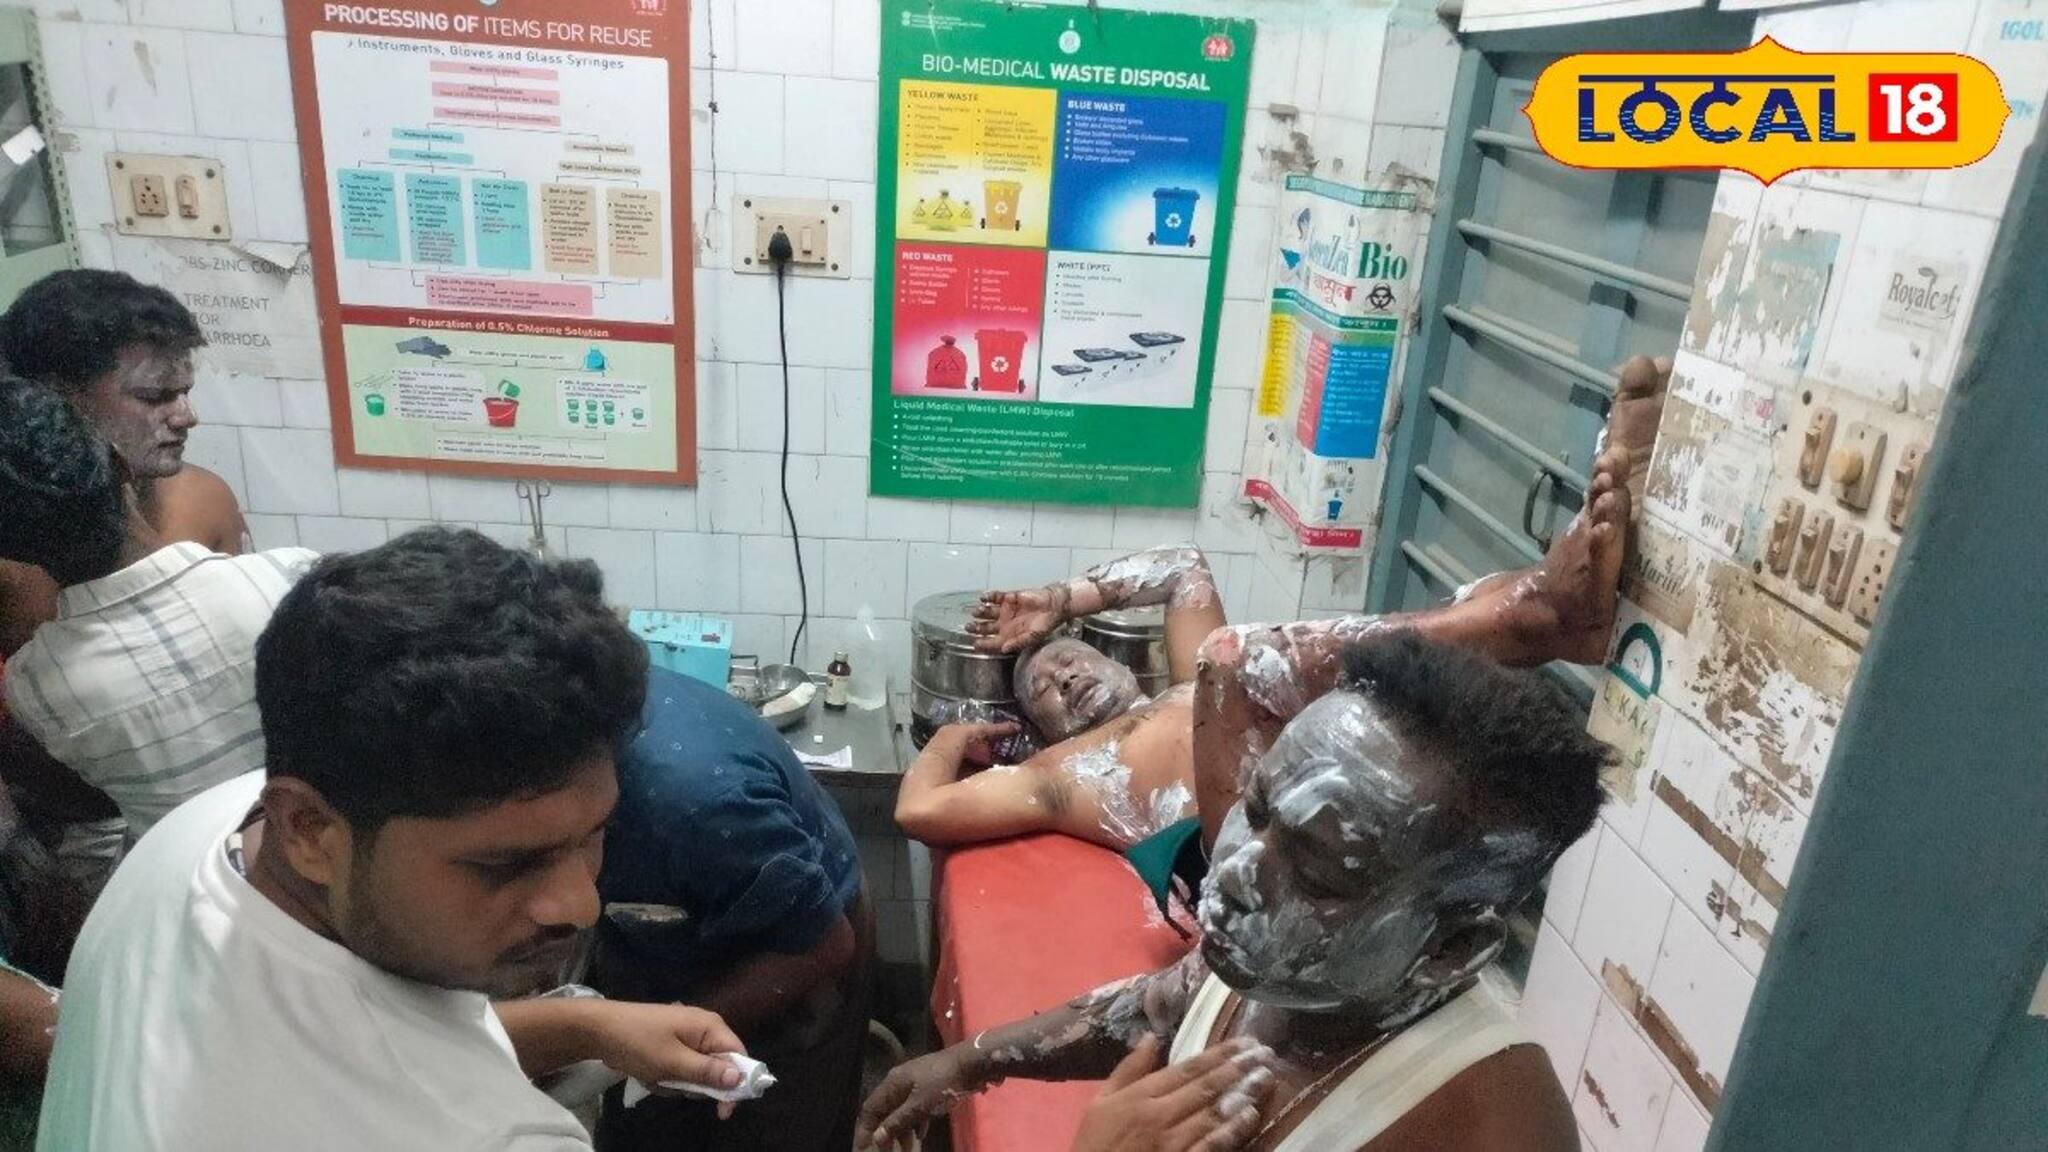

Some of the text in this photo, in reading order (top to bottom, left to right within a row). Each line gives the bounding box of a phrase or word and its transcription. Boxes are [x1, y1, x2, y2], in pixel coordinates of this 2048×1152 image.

[324, 3, 653, 47] PROCESSING OF ITEMS FOR REUSE
[450, 44, 493, 60] Gloves
[498, 50, 522, 61] and
[526, 50, 562, 65] Glass
[567, 55, 625, 69] Syringes
[922, 54, 1210, 91] BIO-MEDICAL WASTE DISPOSAL
[907, 90, 978, 101] YELLOW WASTE
[1068, 100, 1126, 112] BLUE WASTE
[902, 252, 953, 263] RED WASTE
[1358, 241, 1408, 280] Bio
[184, 293, 270, 312] TREATMENT
[408, 316, 610, 338] Preparation of 0.5% Chlorine Solution
[205, 330, 271, 348] ARRHOEA
[893, 400, 924, 411] Liquid
[926, 401, 965, 412] Medical
[967, 403, 997, 413] Waste
[1032, 406, 1075, 420] Disposal
